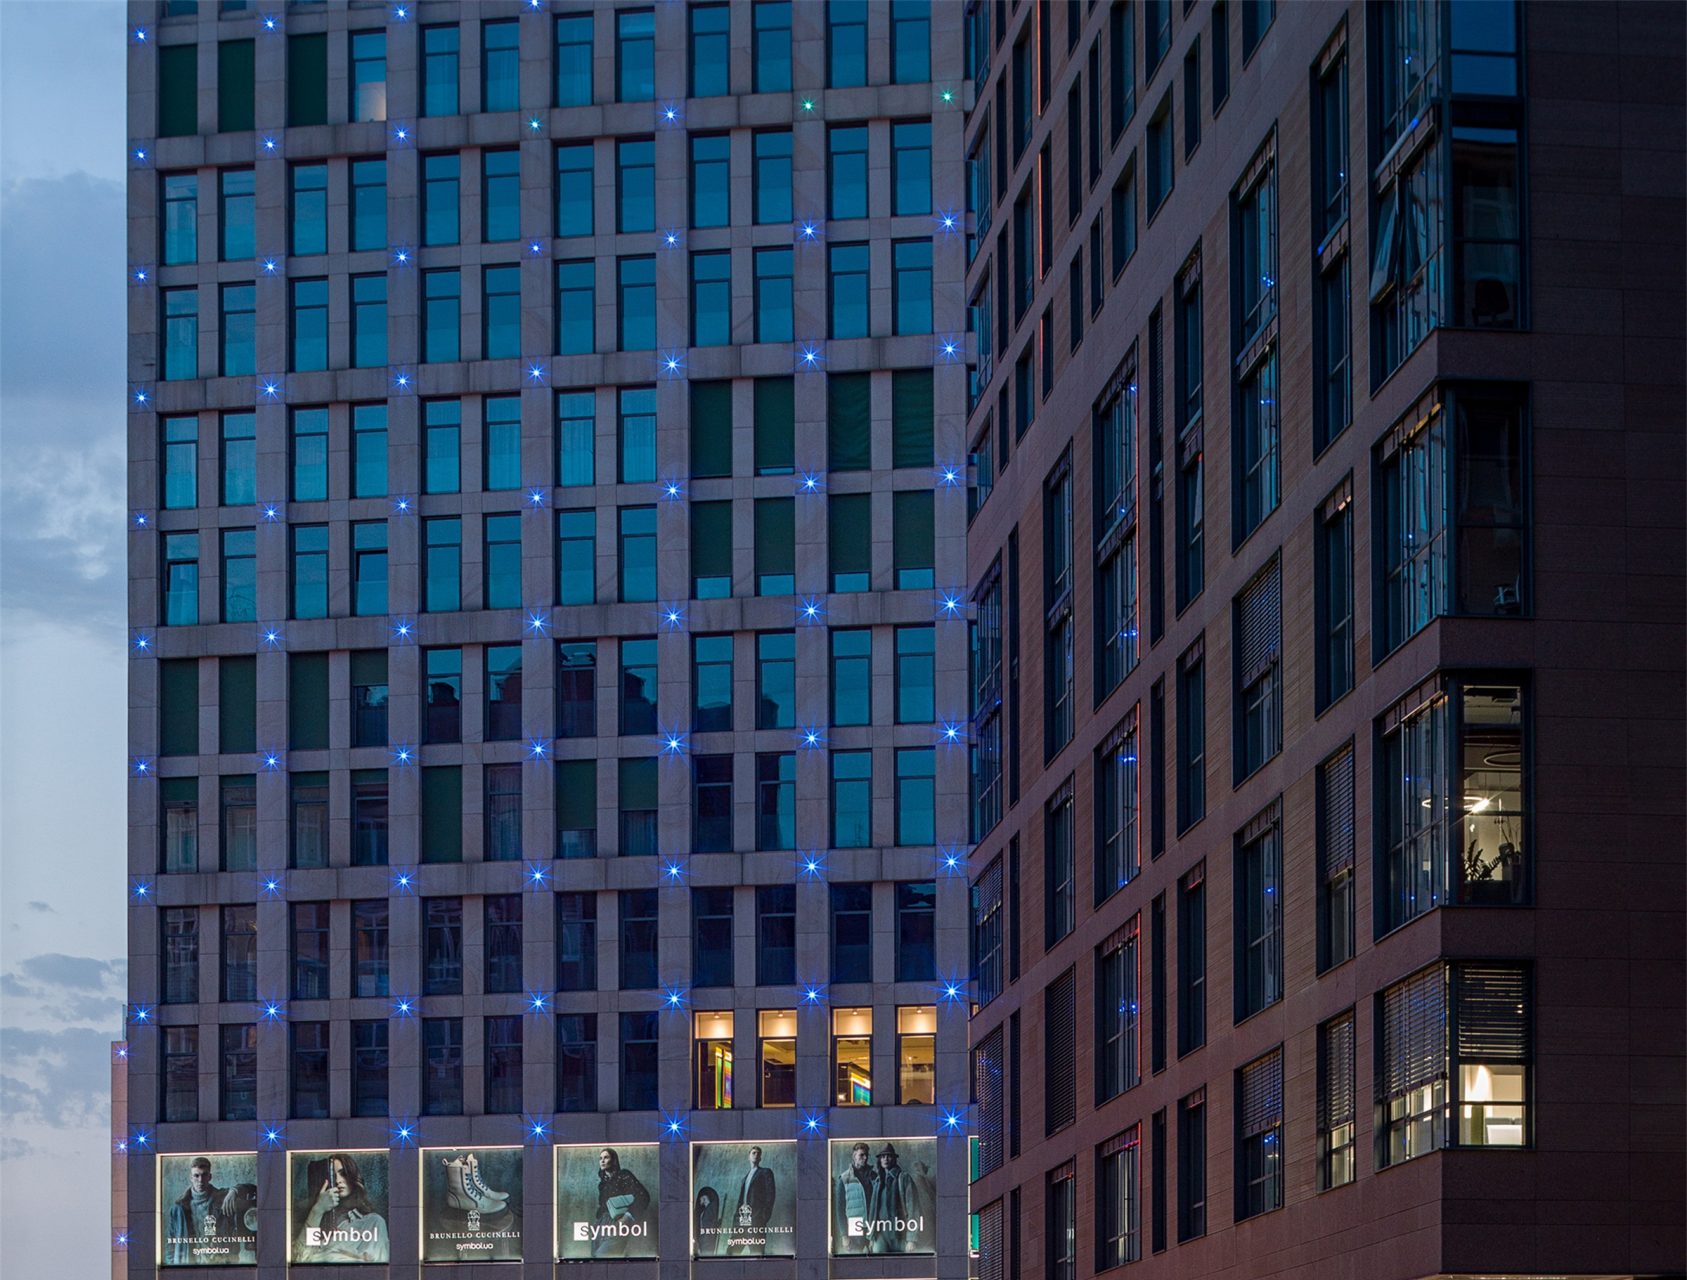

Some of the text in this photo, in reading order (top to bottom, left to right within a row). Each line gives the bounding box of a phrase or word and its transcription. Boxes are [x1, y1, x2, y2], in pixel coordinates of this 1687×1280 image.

[573, 1221, 647, 1241] symbol
[700, 1226, 793, 1235] BRUNELLO CUCINELLI
[848, 1216, 924, 1237] symbol
[306, 1227, 378, 1246] symbol
[727, 1237, 766, 1246] symbol.ua
[456, 1242, 494, 1251] symbol.ua
[192, 1247, 230, 1256] symbol.ua
